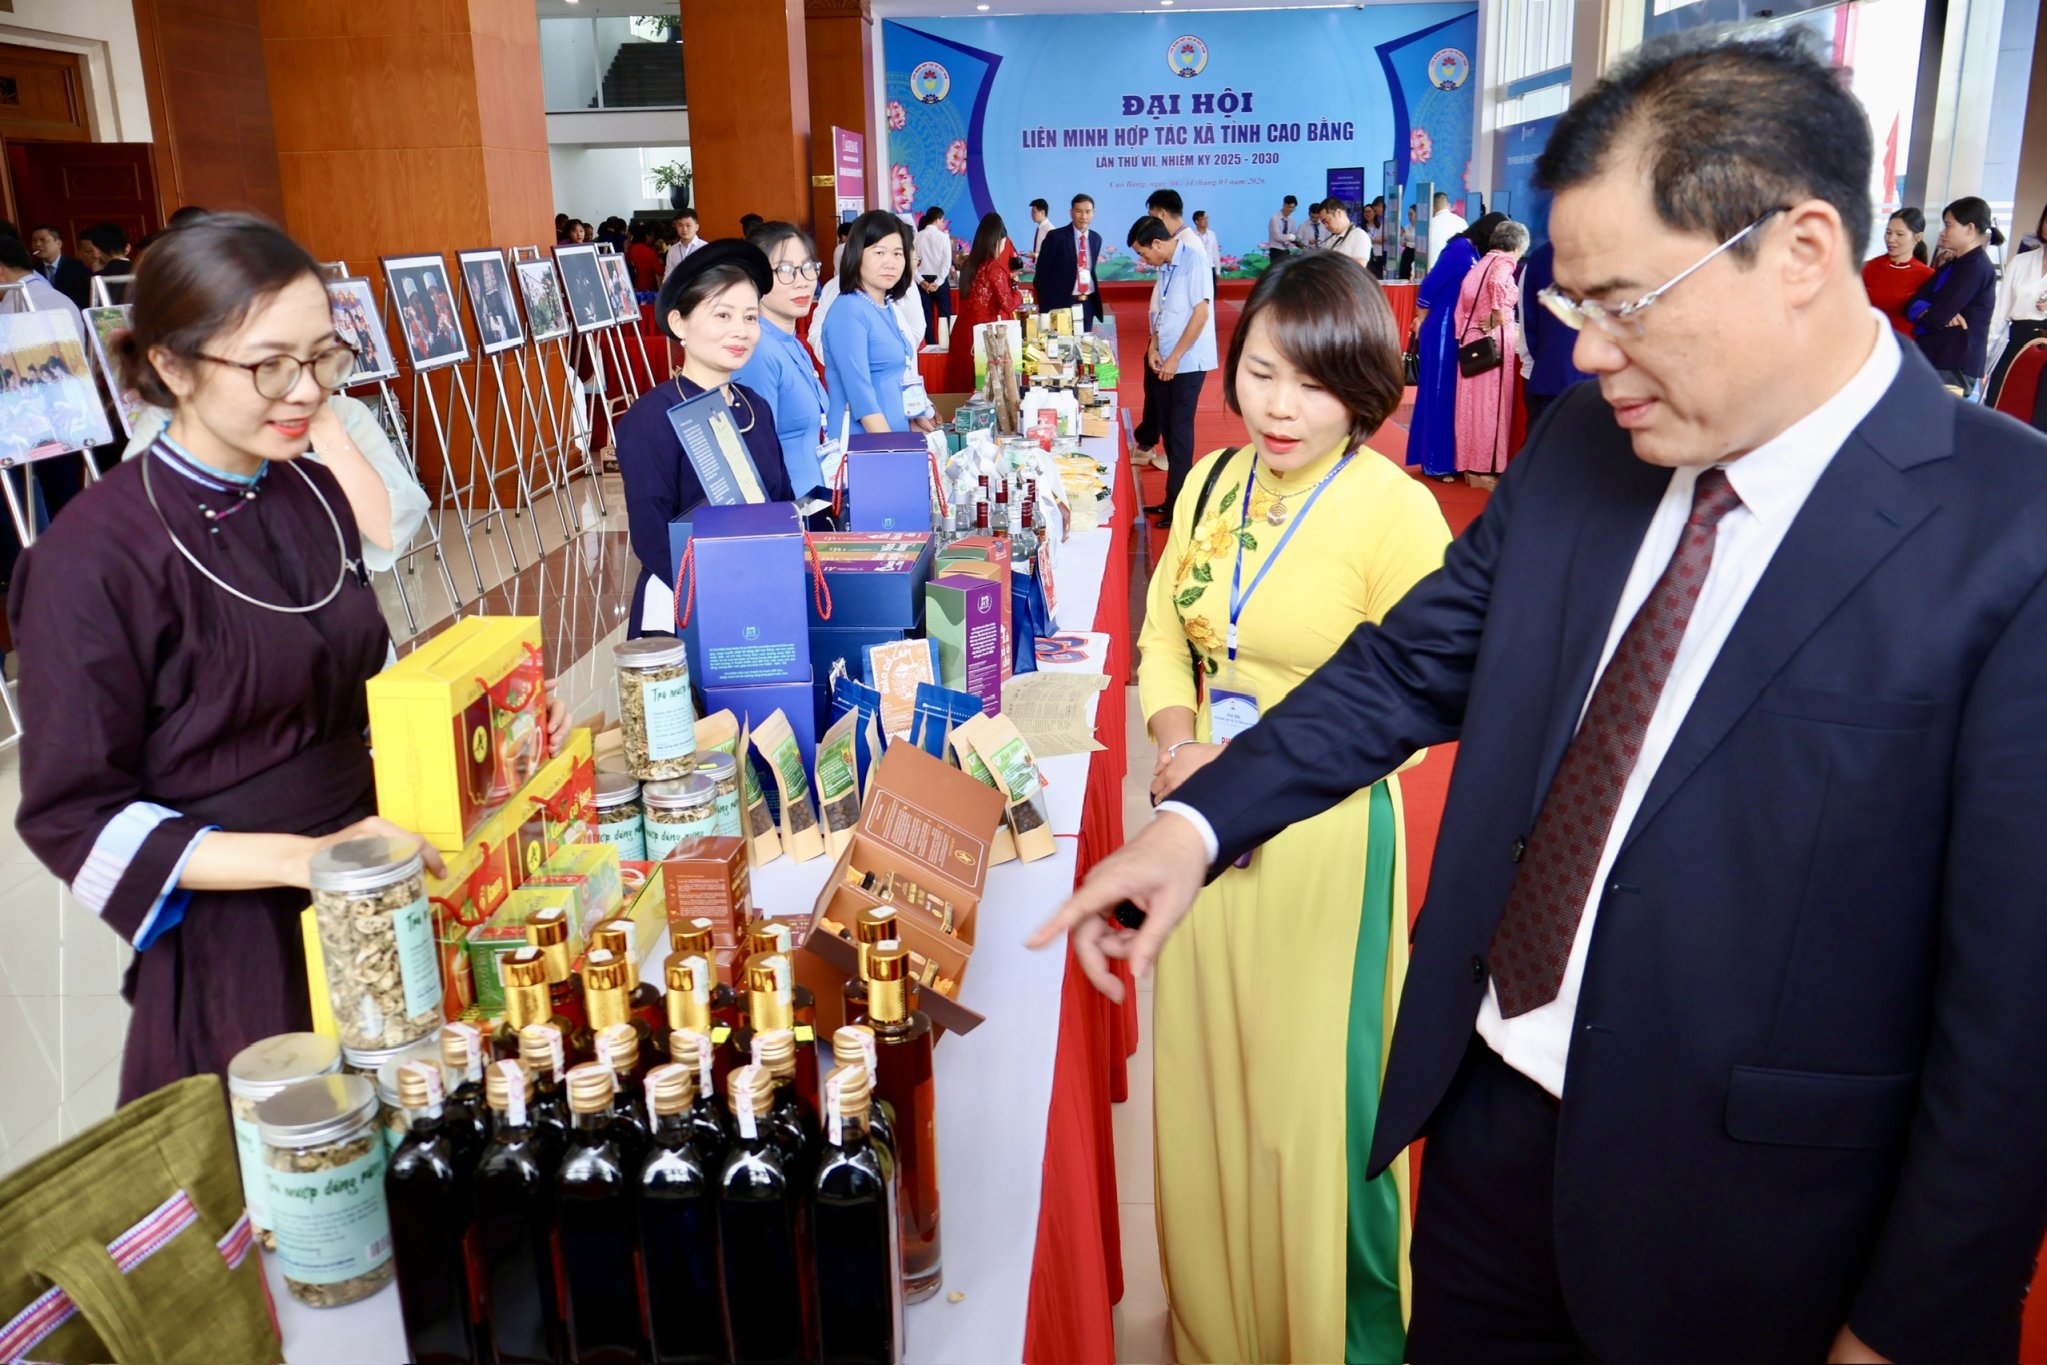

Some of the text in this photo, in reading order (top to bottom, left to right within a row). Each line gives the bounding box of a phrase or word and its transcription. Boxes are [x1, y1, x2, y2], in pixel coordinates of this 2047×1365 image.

[1122, 87, 1253, 120] ĐẠI HỘI
[1022, 116, 1354, 149] LIÊN MINH HỢP TÁC XÃ TỈNH CAO BẰNG
[1161, 153, 1194, 168] NHIỆM
[1214, 152, 1242, 166] 2025
[1251, 152, 1280, 165] 2030
